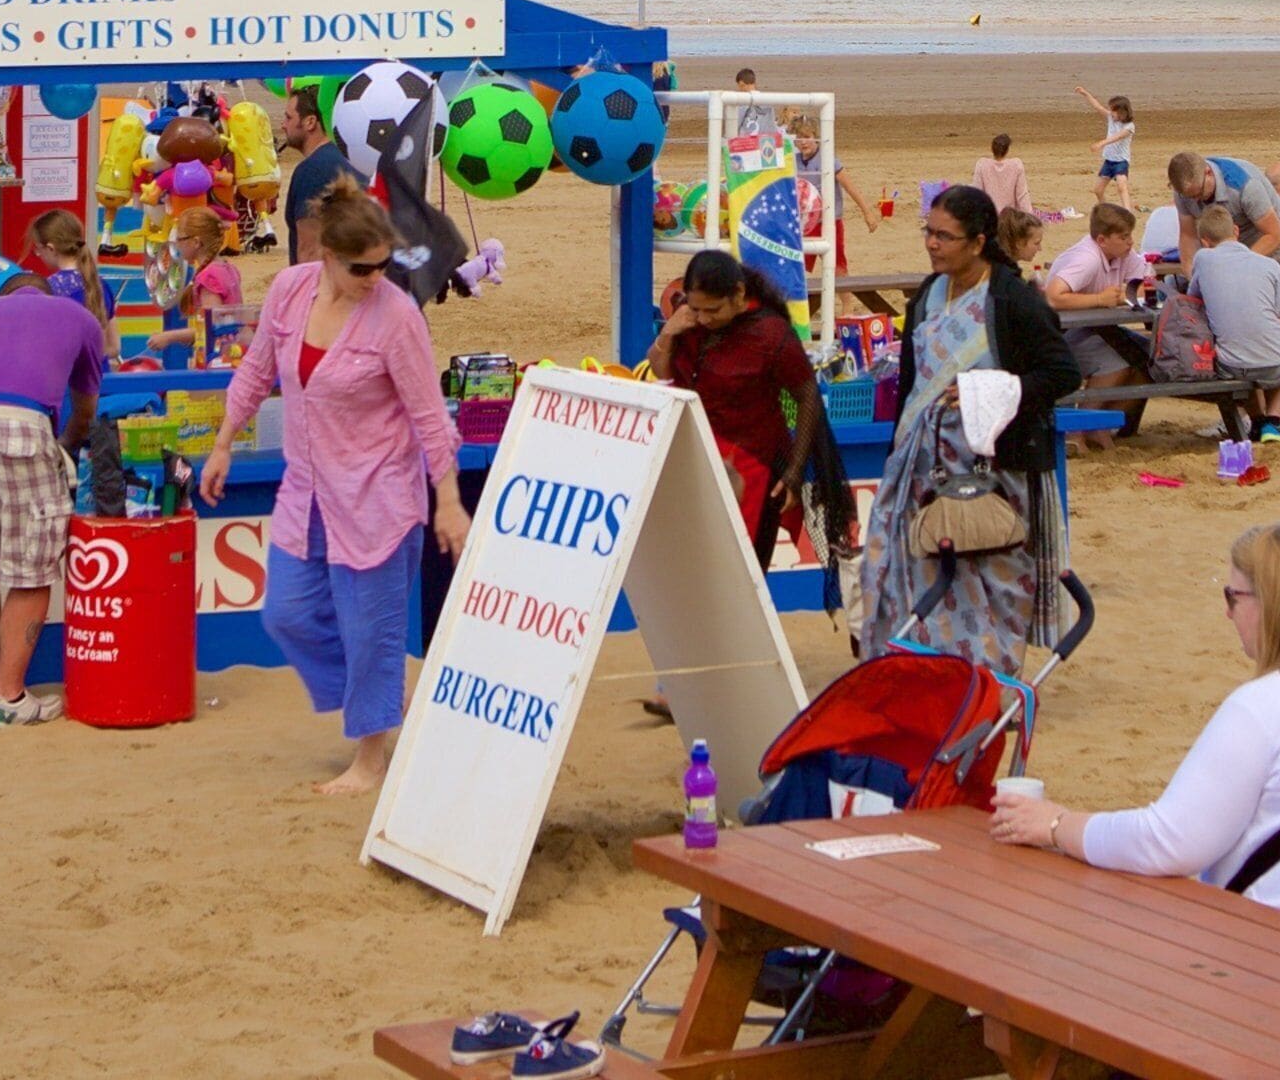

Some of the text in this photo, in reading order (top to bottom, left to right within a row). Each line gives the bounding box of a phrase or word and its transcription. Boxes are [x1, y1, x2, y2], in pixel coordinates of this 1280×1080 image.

[57, 19, 173, 50] GIFTS
[210, 15, 291, 46] HOT
[303, 10, 455, 43] DONUTS
[532, 388, 659, 446] TRAPNELLS
[493, 473, 630, 557] CHIPS
[99, 630, 115, 643] an
[463, 580, 590, 648] HOT DOGS
[432, 665, 559, 743] BURGERS
